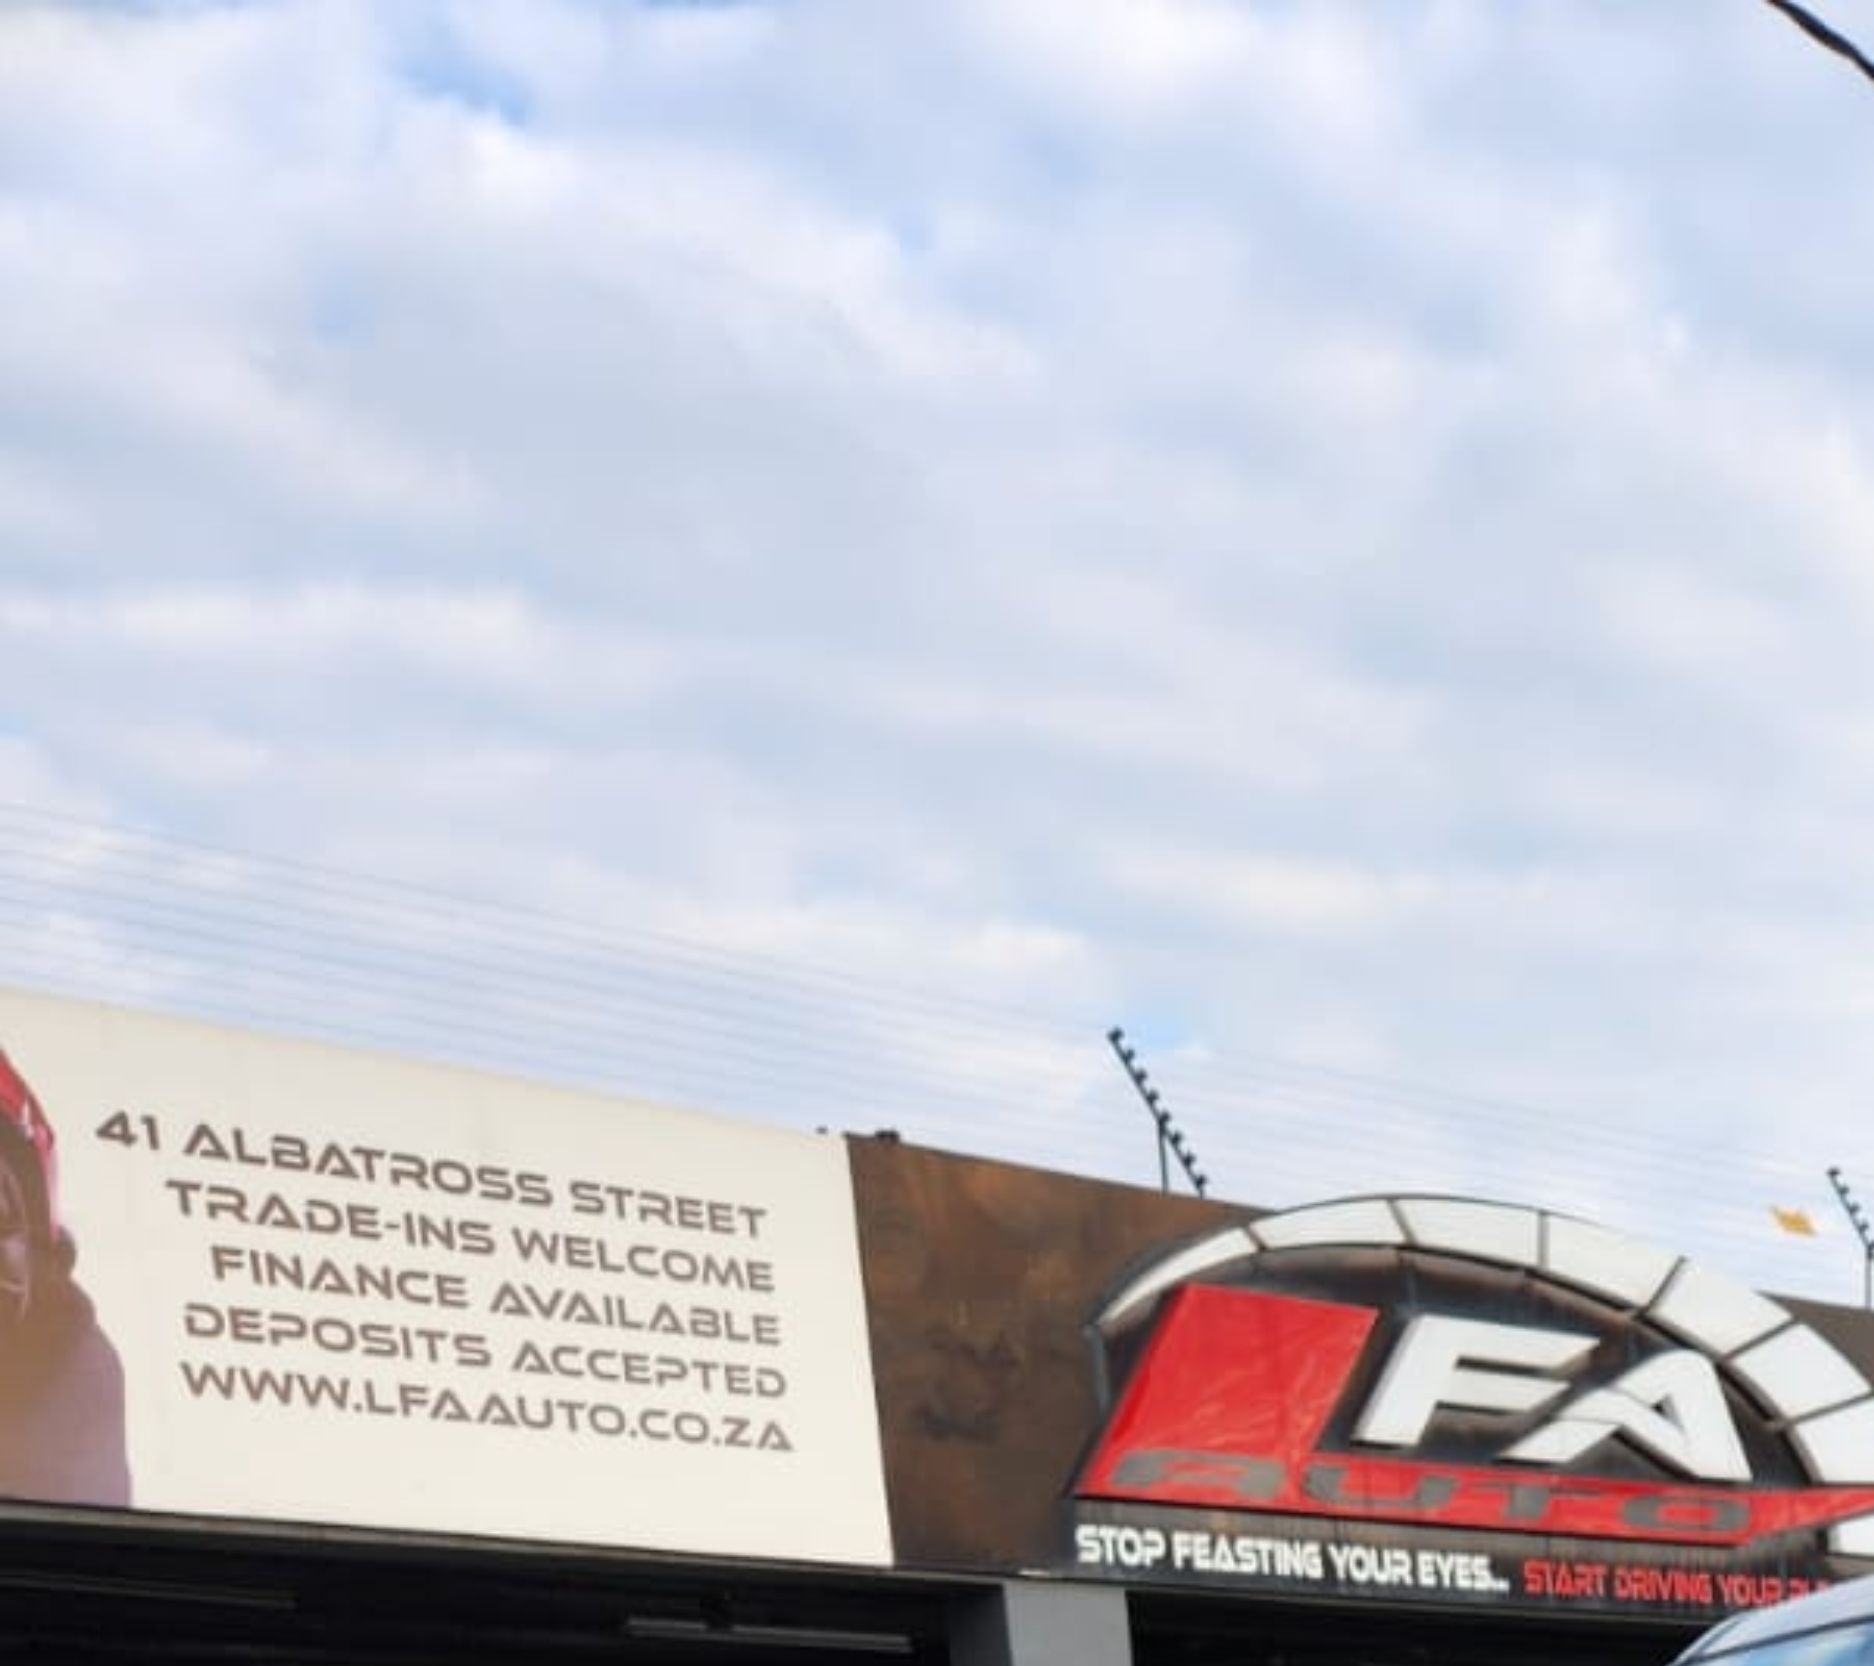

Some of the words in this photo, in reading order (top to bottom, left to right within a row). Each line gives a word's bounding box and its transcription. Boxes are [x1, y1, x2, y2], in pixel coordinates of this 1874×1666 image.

[96, 1110, 161, 1151] 41
[184, 1124, 552, 1207] ALBATROSS
[569, 1180, 767, 1239] STREET
[166, 1179, 495, 1256] TRADE-INS
[512, 1227, 775, 1293] WELCOME
[211, 1246, 468, 1309] FINANCE
[490, 1281, 781, 1346] AVAILABLE
[184, 1302, 491, 1368] DEPOSITS
[512, 1340, 787, 1398] ACCEPTED
[180, 1360, 794, 1452] WWW.LFAAUTO.CO.ZA
[1112, 1448, 1751, 1533] AUTO
[1075, 1524, 1166, 1567] STOP
[1172, 1531, 1322, 1580] FEASTING
[1328, 1543, 1413, 1587] YOUR
[1524, 1559, 1604, 1597] START
[1613, 1566, 1714, 1603] DRIVING
